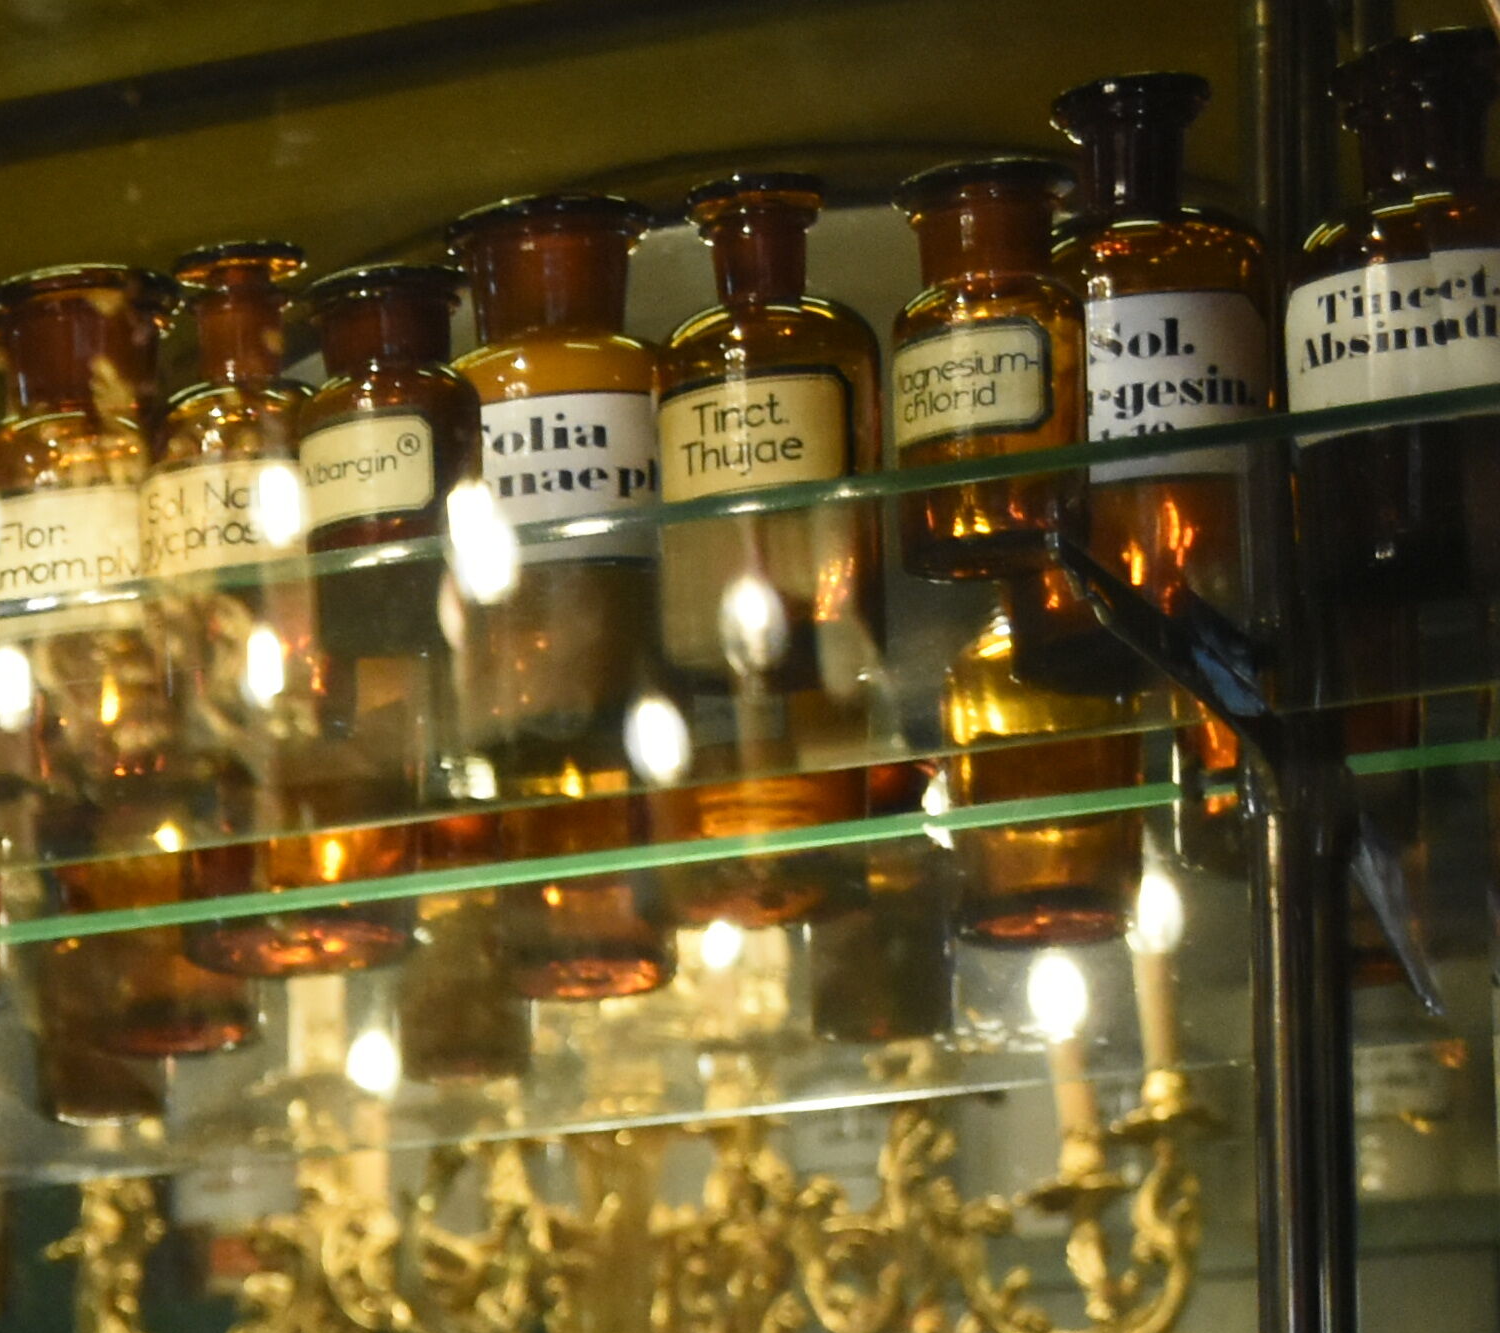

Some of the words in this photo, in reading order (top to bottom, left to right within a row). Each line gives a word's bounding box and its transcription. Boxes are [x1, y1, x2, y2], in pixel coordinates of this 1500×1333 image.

[902, 348, 1040, 395] agnesium-
[692, 393, 789, 437] Tinct.
[904, 384, 998, 424] chlorid
[482, 411, 607, 456] olia
[680, 435, 804, 477] Thujae
